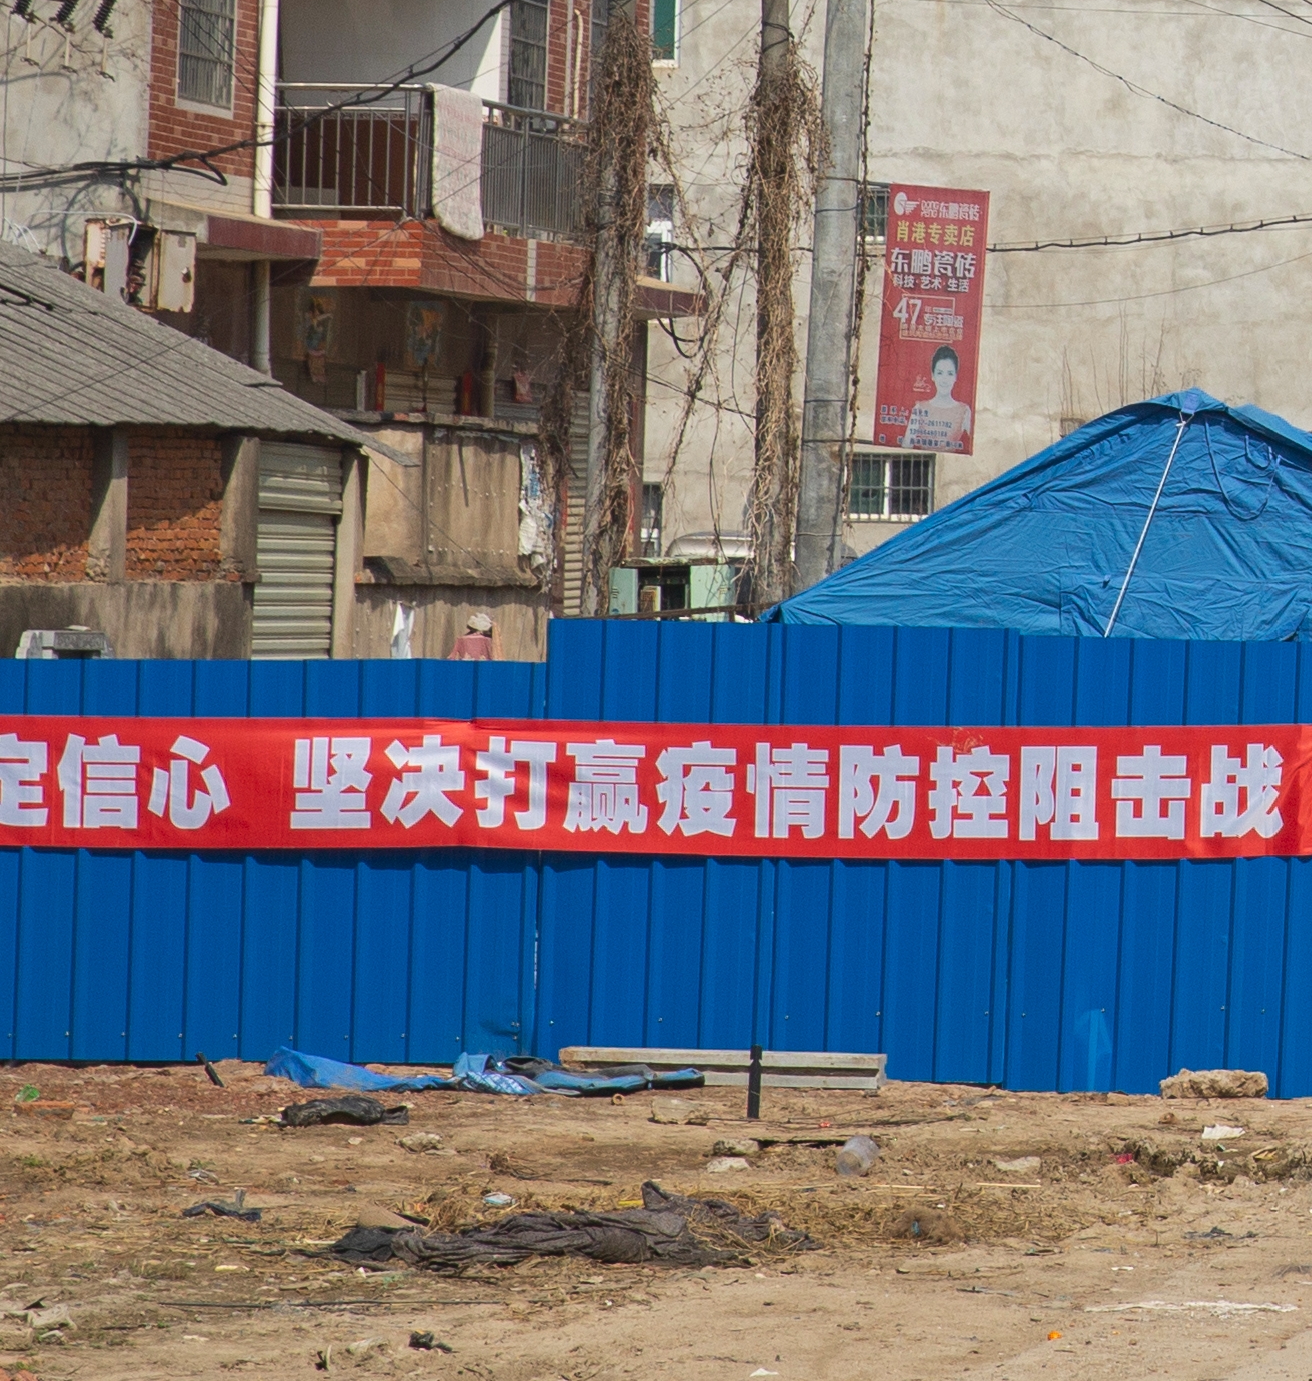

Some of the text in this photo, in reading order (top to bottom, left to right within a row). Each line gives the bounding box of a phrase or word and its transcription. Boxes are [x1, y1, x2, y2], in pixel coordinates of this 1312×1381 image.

[896, 220, 975, 246] 肖港专卖店
[890, 247, 977, 279] 东鹏瓷砖
[893, 297, 922, 325] 47
[0, 733, 1283, 840] 定信心 坚决打赢疫情防控阻击战
